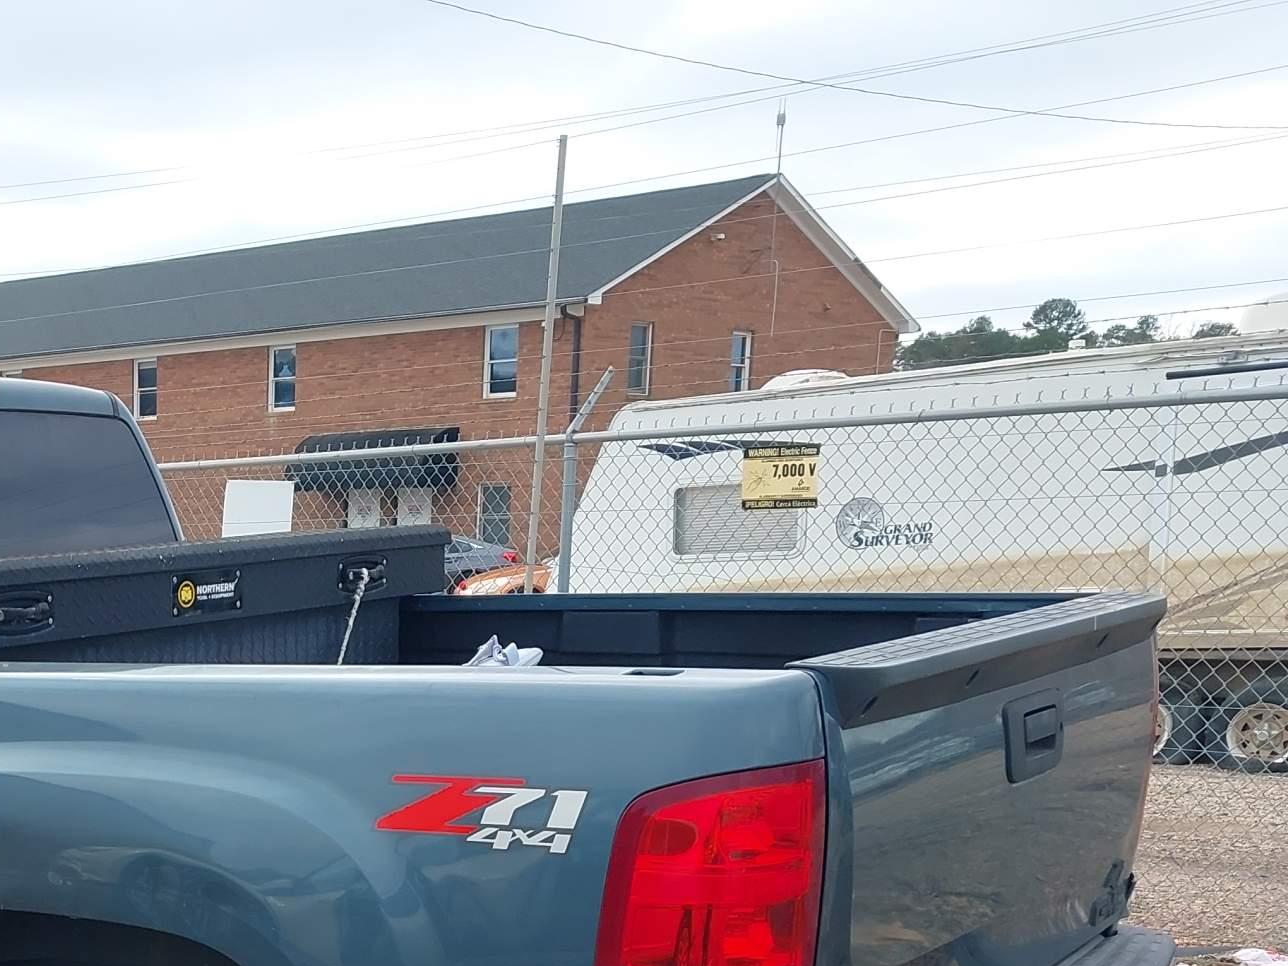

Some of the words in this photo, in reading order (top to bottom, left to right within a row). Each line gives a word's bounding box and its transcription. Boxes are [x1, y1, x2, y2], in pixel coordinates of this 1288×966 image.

[748, 447, 780, 457] WARNING!
[773, 463, 805, 480] 7,000
[809, 463, 817, 477] V
[884, 521, 933, 535] GRAND
[851, 531, 934, 548] SURVEYOR
[197, 582, 235, 594] NORTHERN
[376, 774, 589, 836] Z71
